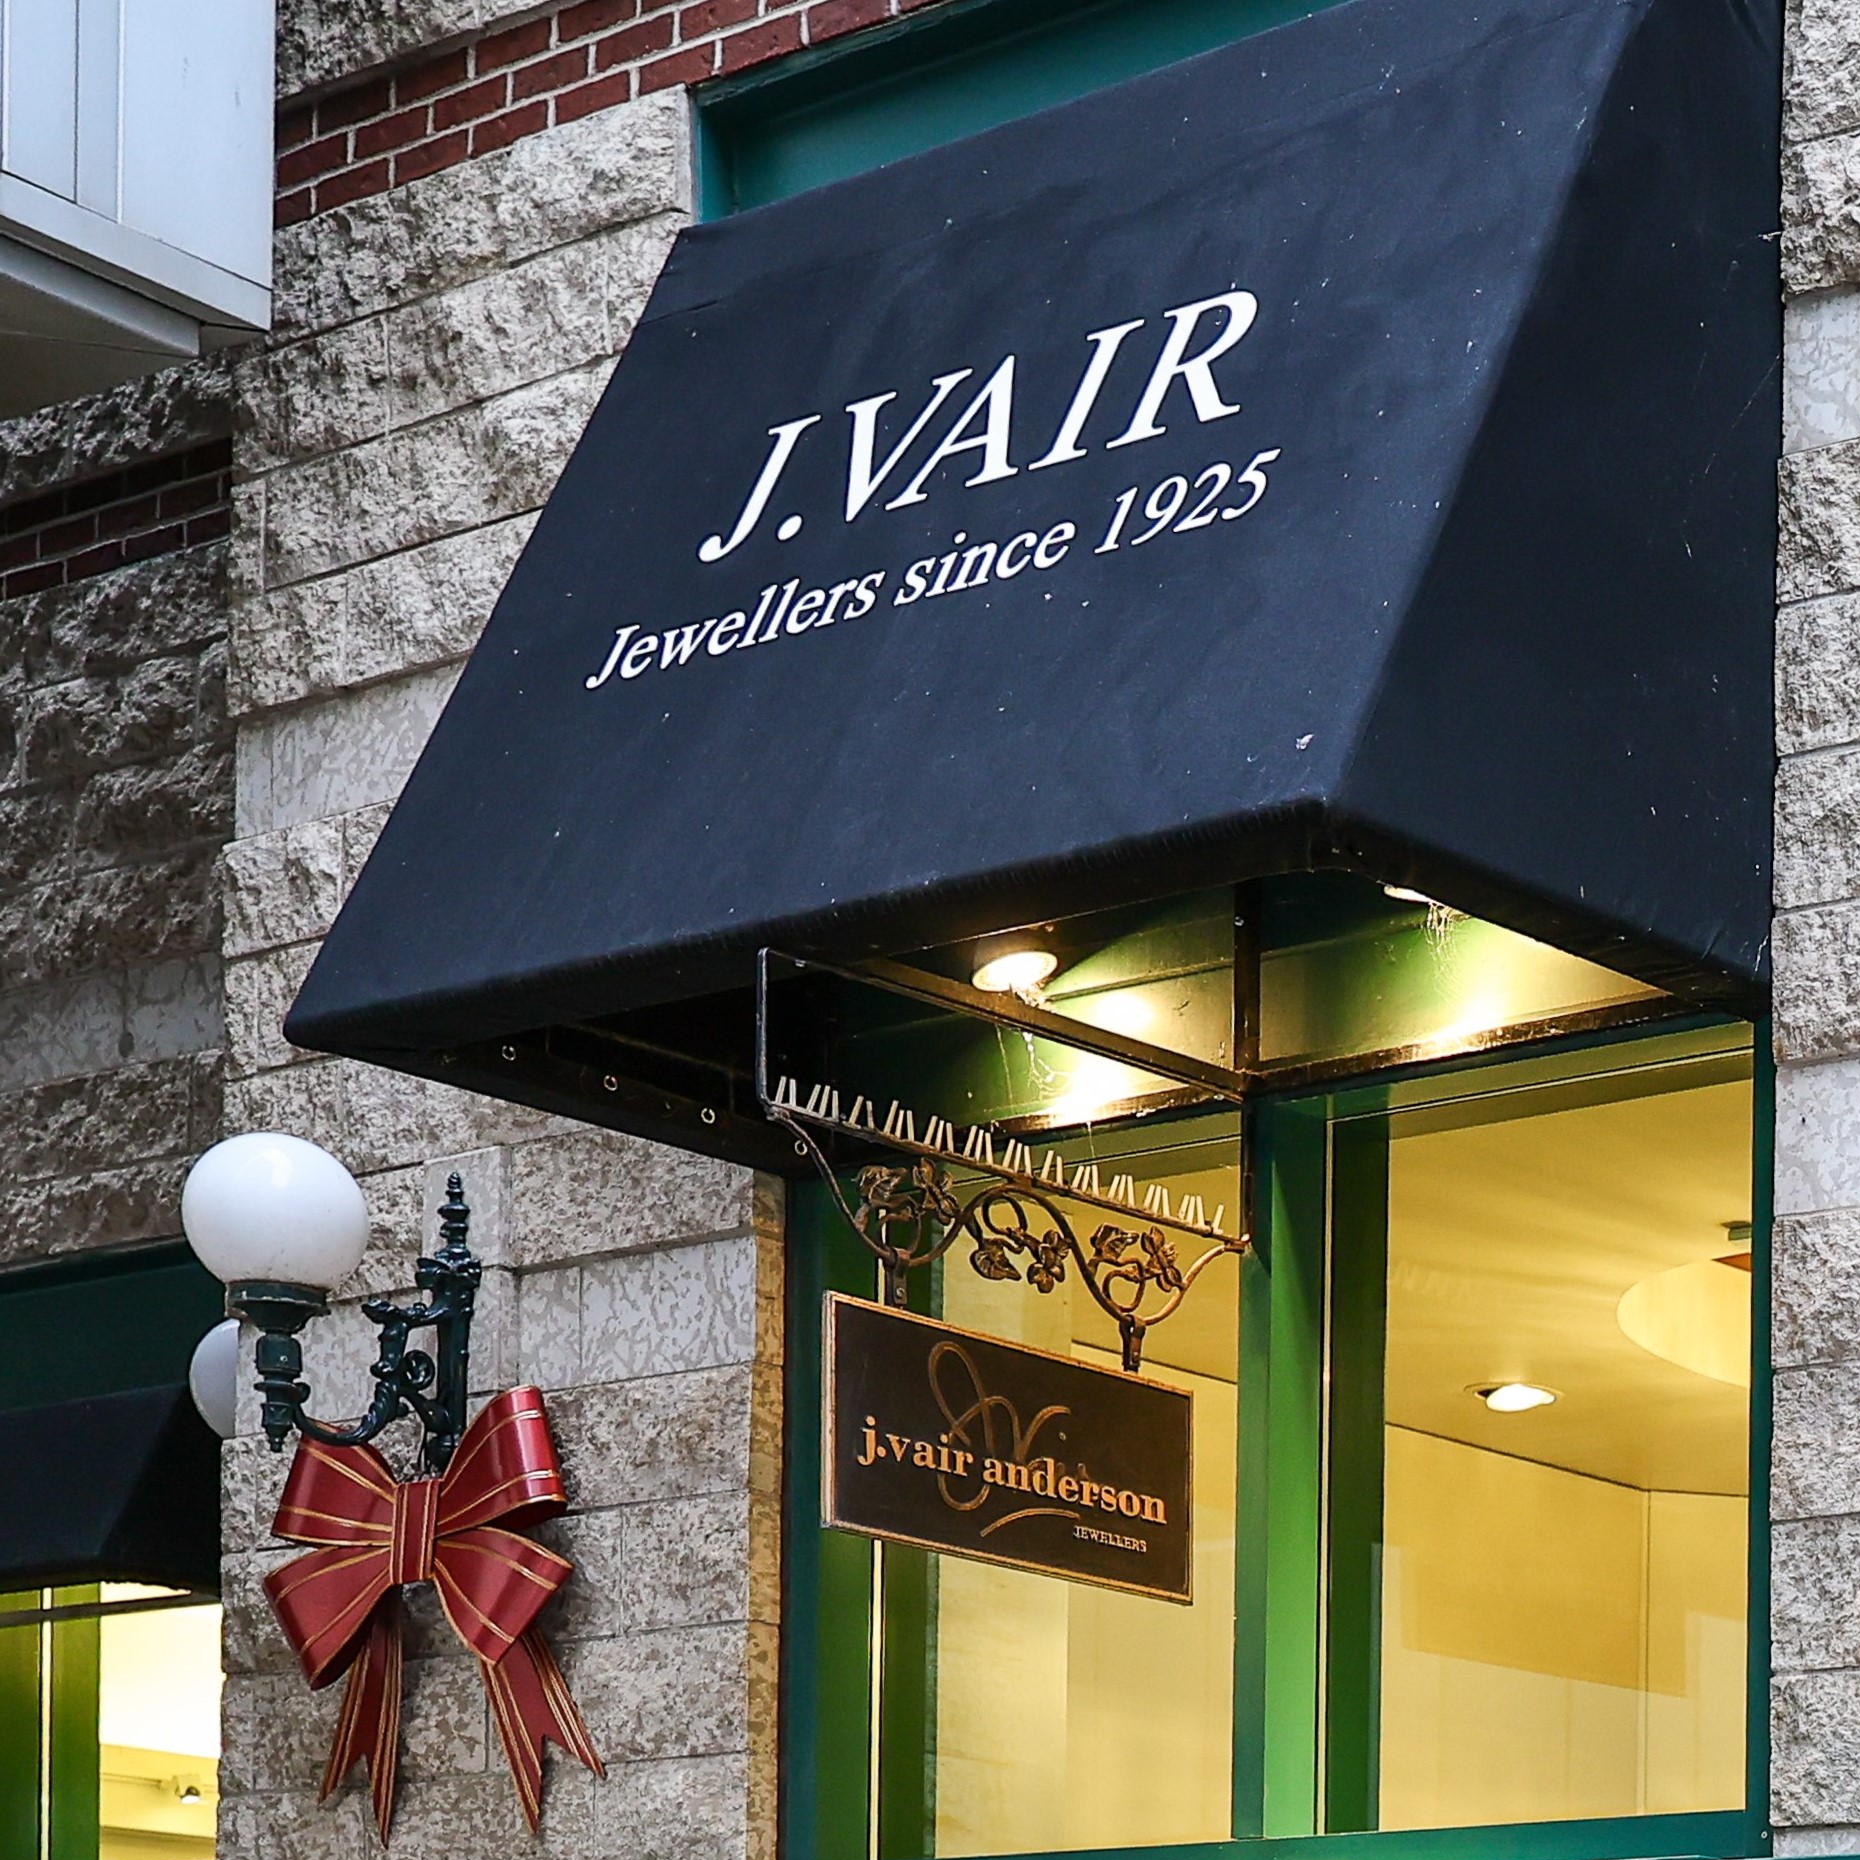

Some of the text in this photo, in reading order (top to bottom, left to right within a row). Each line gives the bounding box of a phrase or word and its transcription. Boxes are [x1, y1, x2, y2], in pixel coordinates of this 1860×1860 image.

[698, 290, 1259, 563] J.VAIR
[584, 448, 1282, 690] Jewellers since 1925
[856, 1415, 1168, 1526] j.vair anderson
[1072, 1524, 1148, 1554] JEWELLERS
